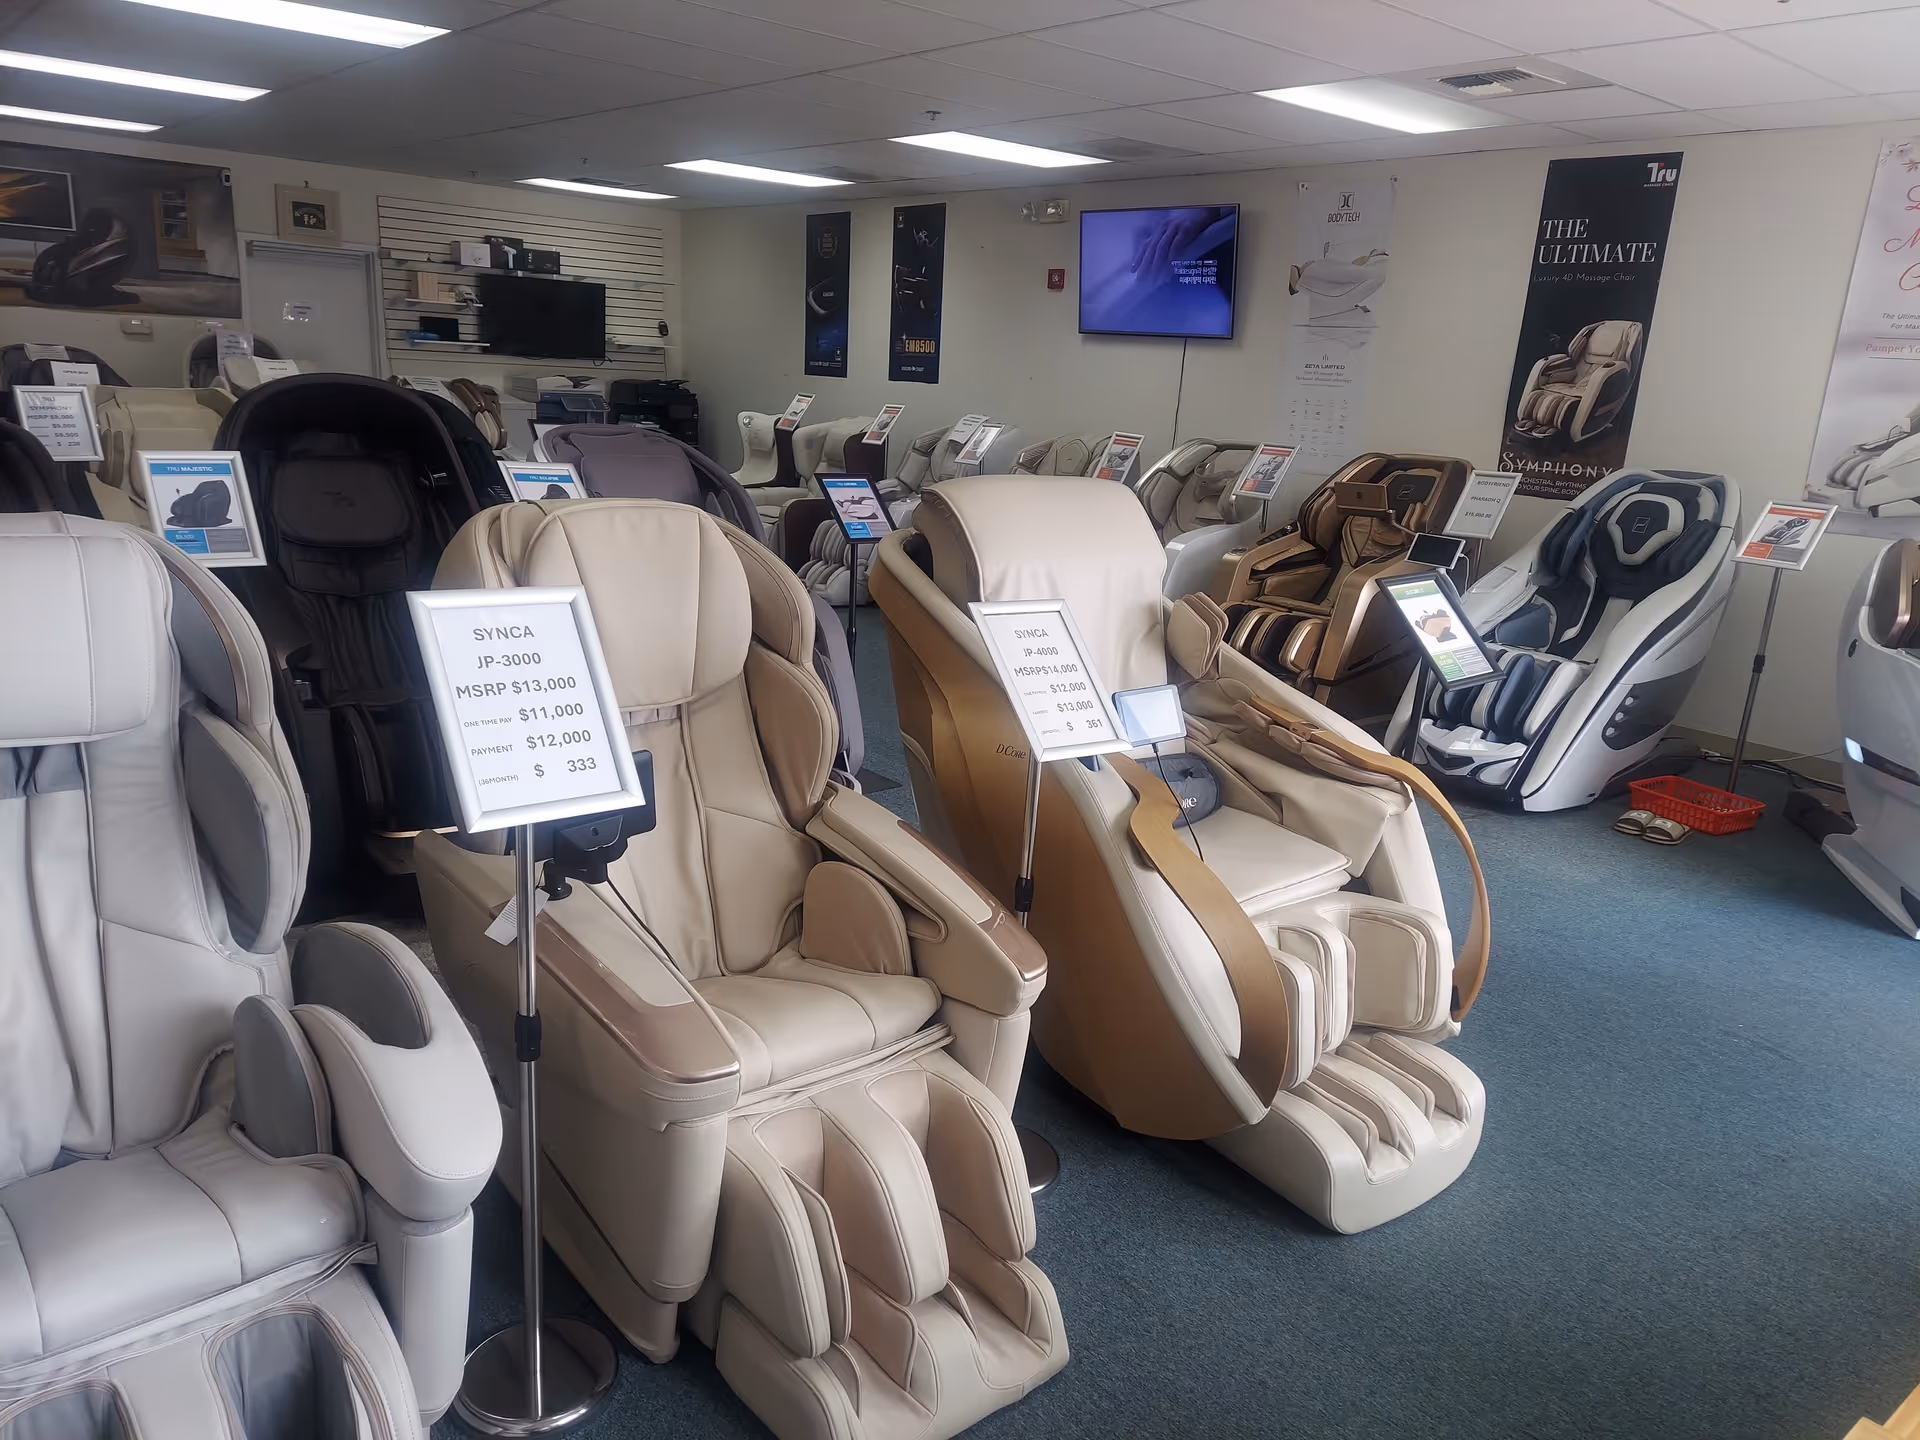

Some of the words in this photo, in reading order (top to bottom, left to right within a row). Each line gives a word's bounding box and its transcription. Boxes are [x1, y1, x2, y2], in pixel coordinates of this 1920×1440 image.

[1647, 162, 1678, 183] Tru
[1327, 211, 1361, 223] BODYTECH
[1543, 218, 1589, 239] THE
[1538, 242, 1657, 265] ULTIMATE
[1534, 273, 1560, 283] Luxury
[1562, 273, 1574, 281] 4D
[1576, 273, 1611, 283] Massage
[1613, 272, 1636, 281] Chair
[1890, 322, 1903, 330] For
[905, 339, 936, 353] EM8500
[1500, 451, 1613, 479] SYMPHONY
[1477, 480, 1511, 488] BODYFRIEND
[1519, 477, 1555, 487] RCHESTRAL
[1555, 480, 1587, 490] RHYTHMS
[1523, 484, 1541, 492] YOUR
[473, 625, 535, 641] SYNCA
[1014, 628, 1049, 640] SYNCA
[1023, 646, 1059, 658] JP-4000
[477, 652, 542, 669] JP-3000
[456, 682, 507, 699] MSRP
[512, 676, 577, 696] $13,000
[1050, 681, 1087, 694] $12,000
[1056, 700, 1094, 713] $13,000
[464, 719, 480, 728] ONE
[481, 718, 498, 727] TIME
[499, 717, 513, 725] PAY
[518, 702, 584, 723] $11,000
[1066, 721, 1074, 732] $
[1086, 719, 1103, 730] 361
[471, 744, 514, 757] PAYMENT
[526, 729, 592, 751] $12,000
[478, 774, 519, 787] (36MONTH)
[534, 763, 545, 779] $
[566, 756, 597, 773] 333
